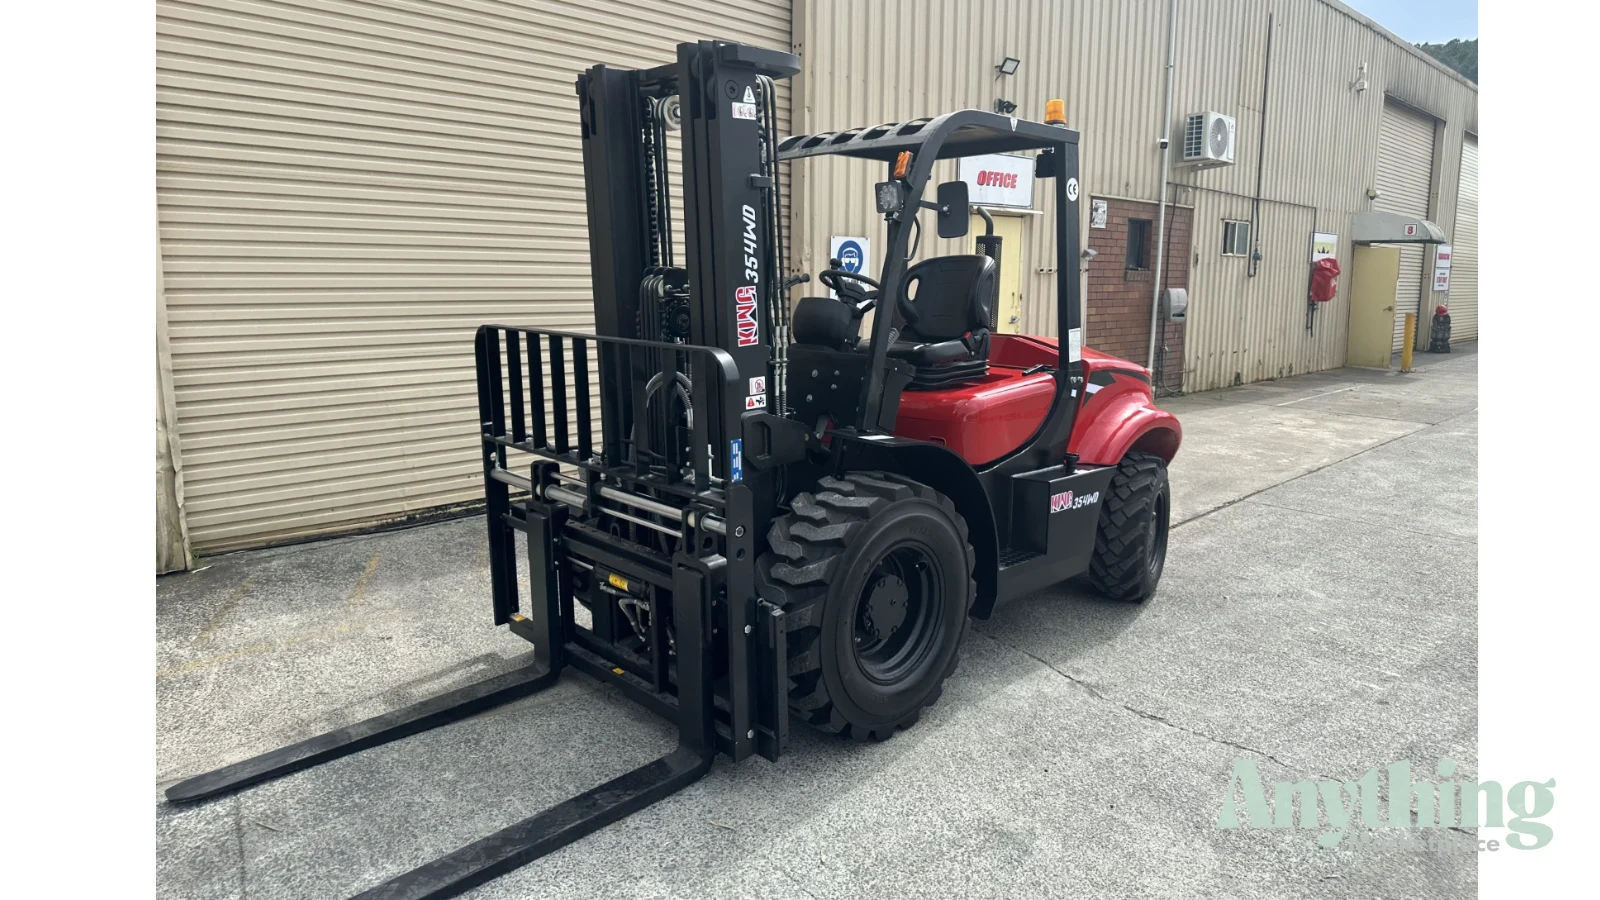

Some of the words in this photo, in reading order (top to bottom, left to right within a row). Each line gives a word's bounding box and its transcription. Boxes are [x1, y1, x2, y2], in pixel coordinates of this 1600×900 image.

[977, 170, 1018, 189] OFFICE
[1068, 183, 1077, 195] CE
[1407, 225, 1414, 235] 8
[735, 285, 759, 347] KING
